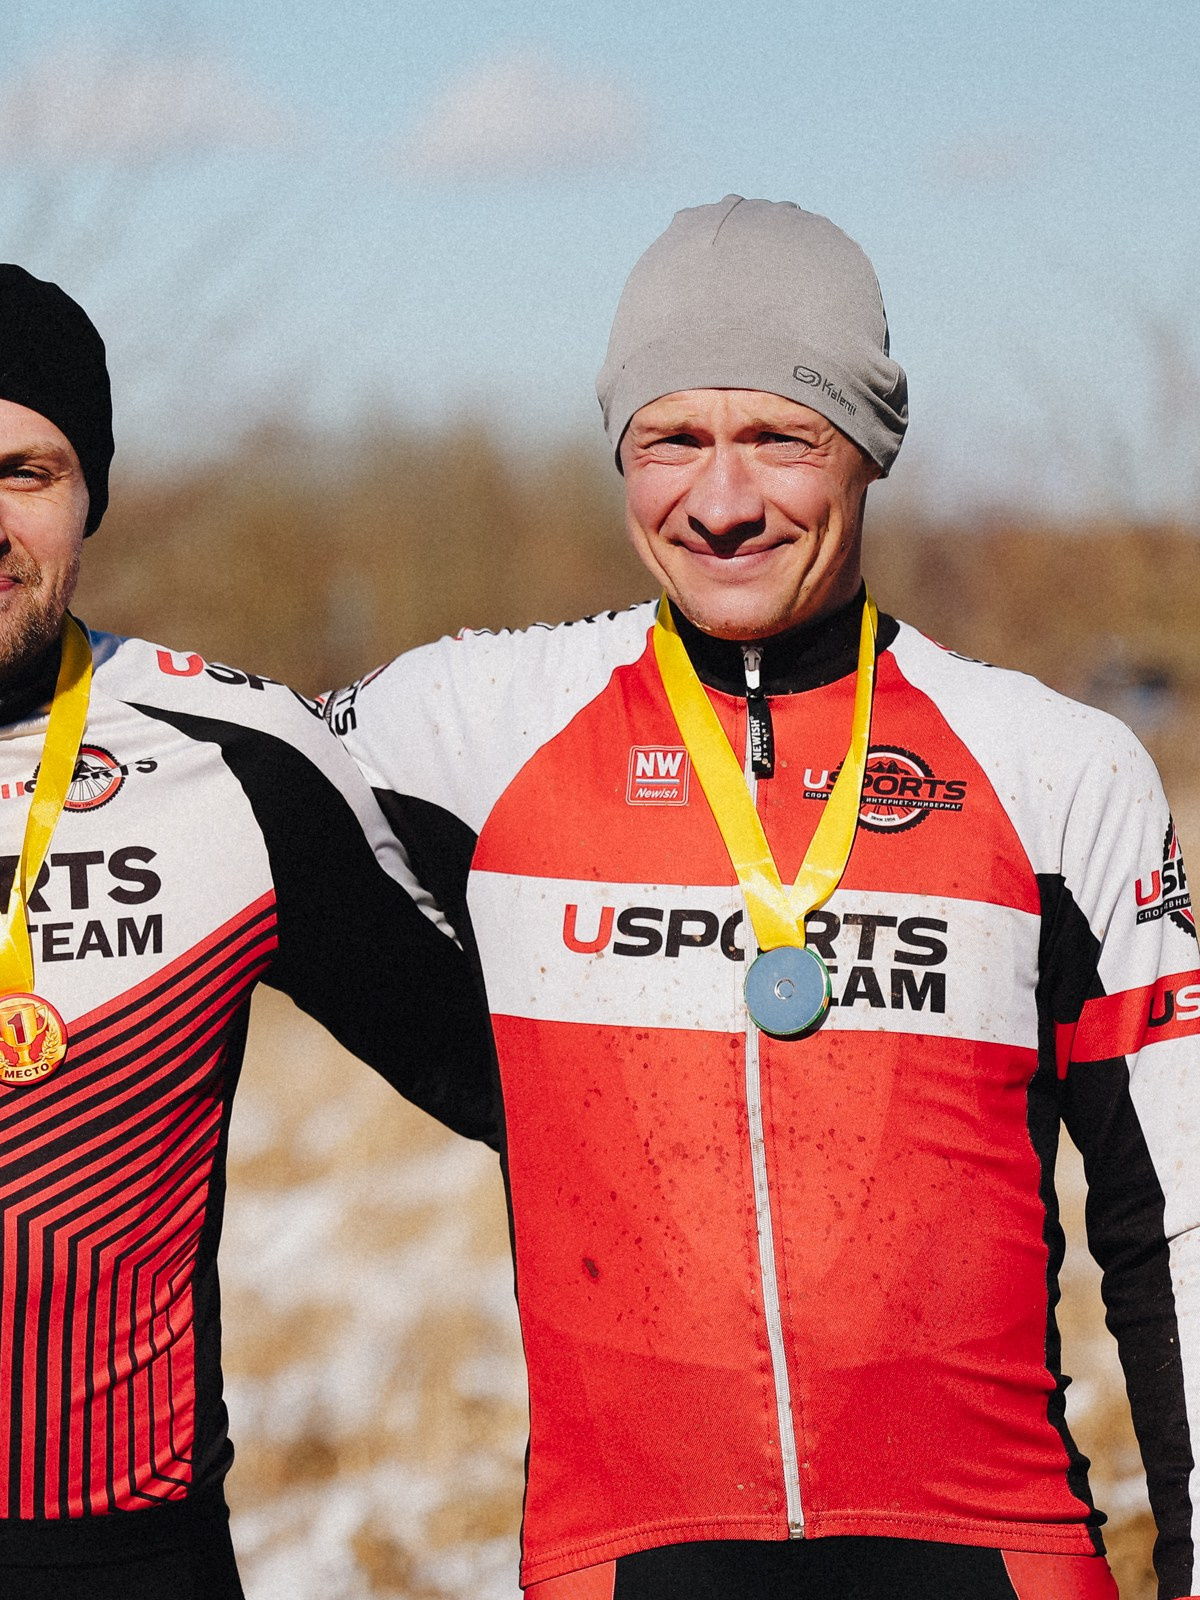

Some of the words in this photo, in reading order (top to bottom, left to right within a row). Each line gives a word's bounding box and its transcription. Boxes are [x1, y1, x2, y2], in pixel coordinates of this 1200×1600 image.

[821, 378, 857, 416] Kalenji
[635, 752, 684, 777] NW
[635, 788, 679, 798] Newish
[7, 1011, 27, 1045] 1
[4, 1063, 50, 1079] МЕСТО
